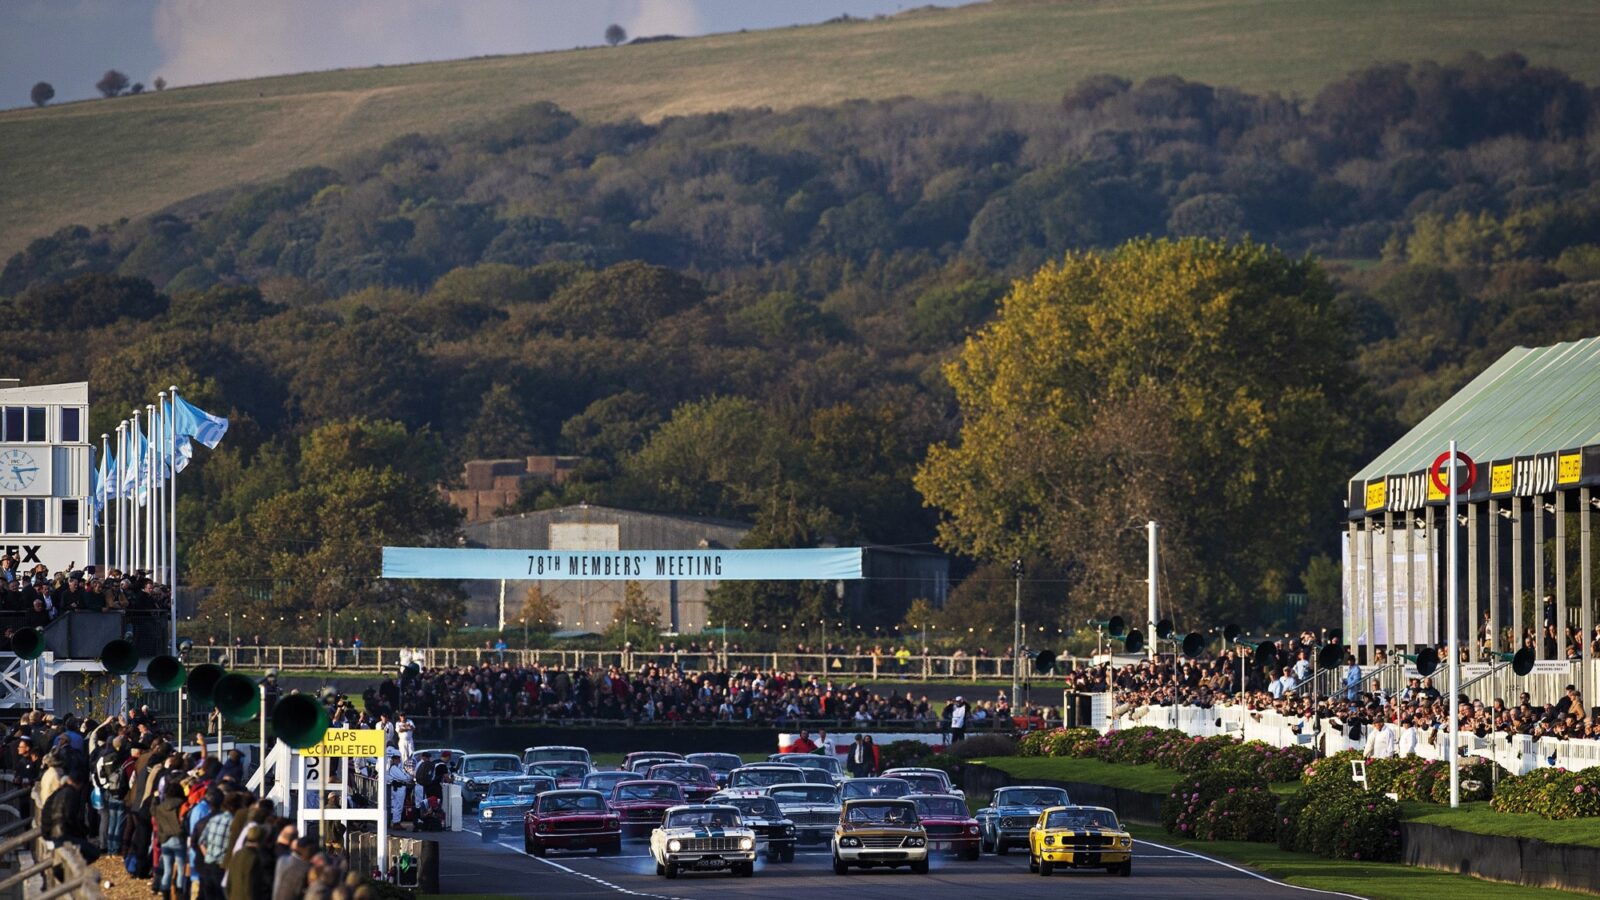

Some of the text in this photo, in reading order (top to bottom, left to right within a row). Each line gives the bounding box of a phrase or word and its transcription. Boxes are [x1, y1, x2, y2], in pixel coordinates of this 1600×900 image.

[1515, 456, 1555, 496] FERODO
[1388, 474, 1425, 512] FERODO
[528, 555, 722, 576] 78TH MEMBERS' MEETING
[327, 731, 357, 742] LAPS
